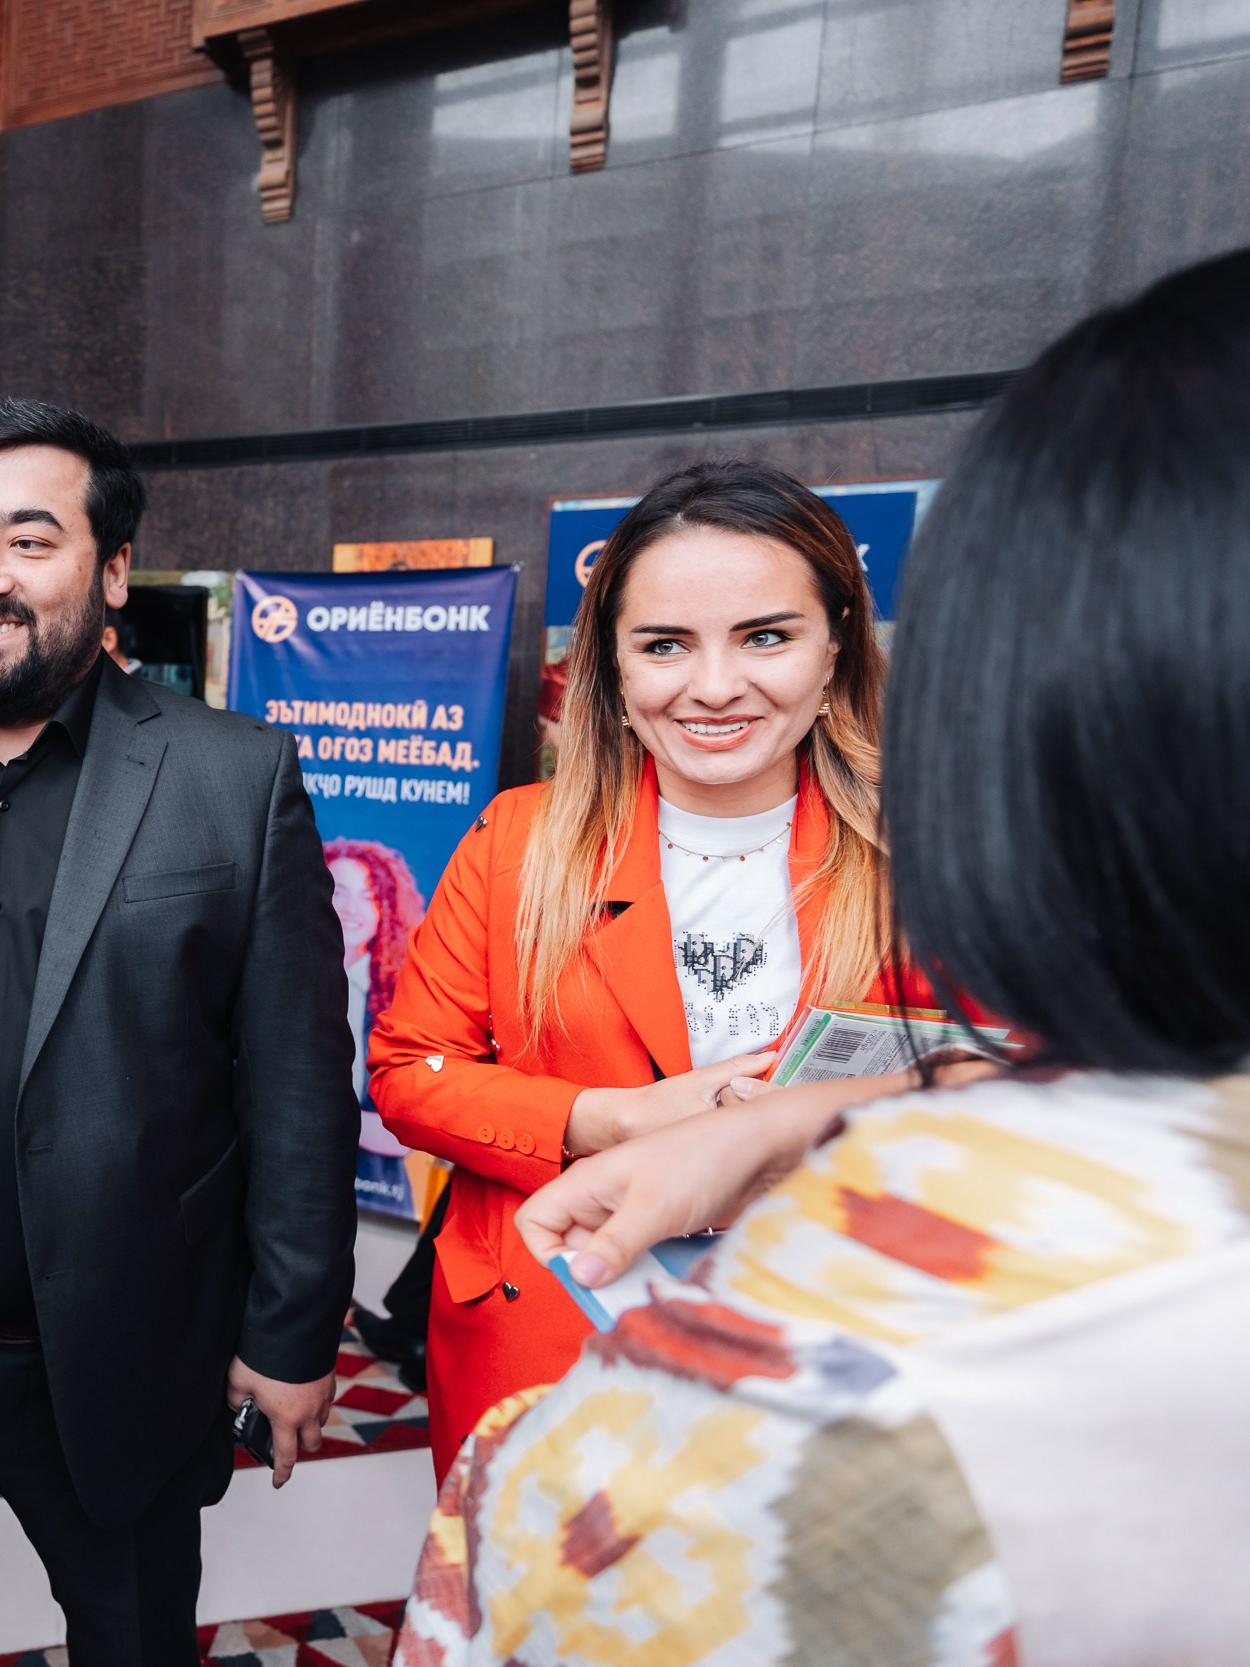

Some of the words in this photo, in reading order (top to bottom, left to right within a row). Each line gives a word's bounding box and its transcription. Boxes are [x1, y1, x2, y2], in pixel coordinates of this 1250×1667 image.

[306, 601, 492, 632] ОРИЁНБОНК
[431, 704, 464, 731] АЗ
[377, 735, 481, 773] МЕЁБАД.
[344, 775, 398, 804] РУШД
[400, 779, 471, 806] КУНЕМ!
